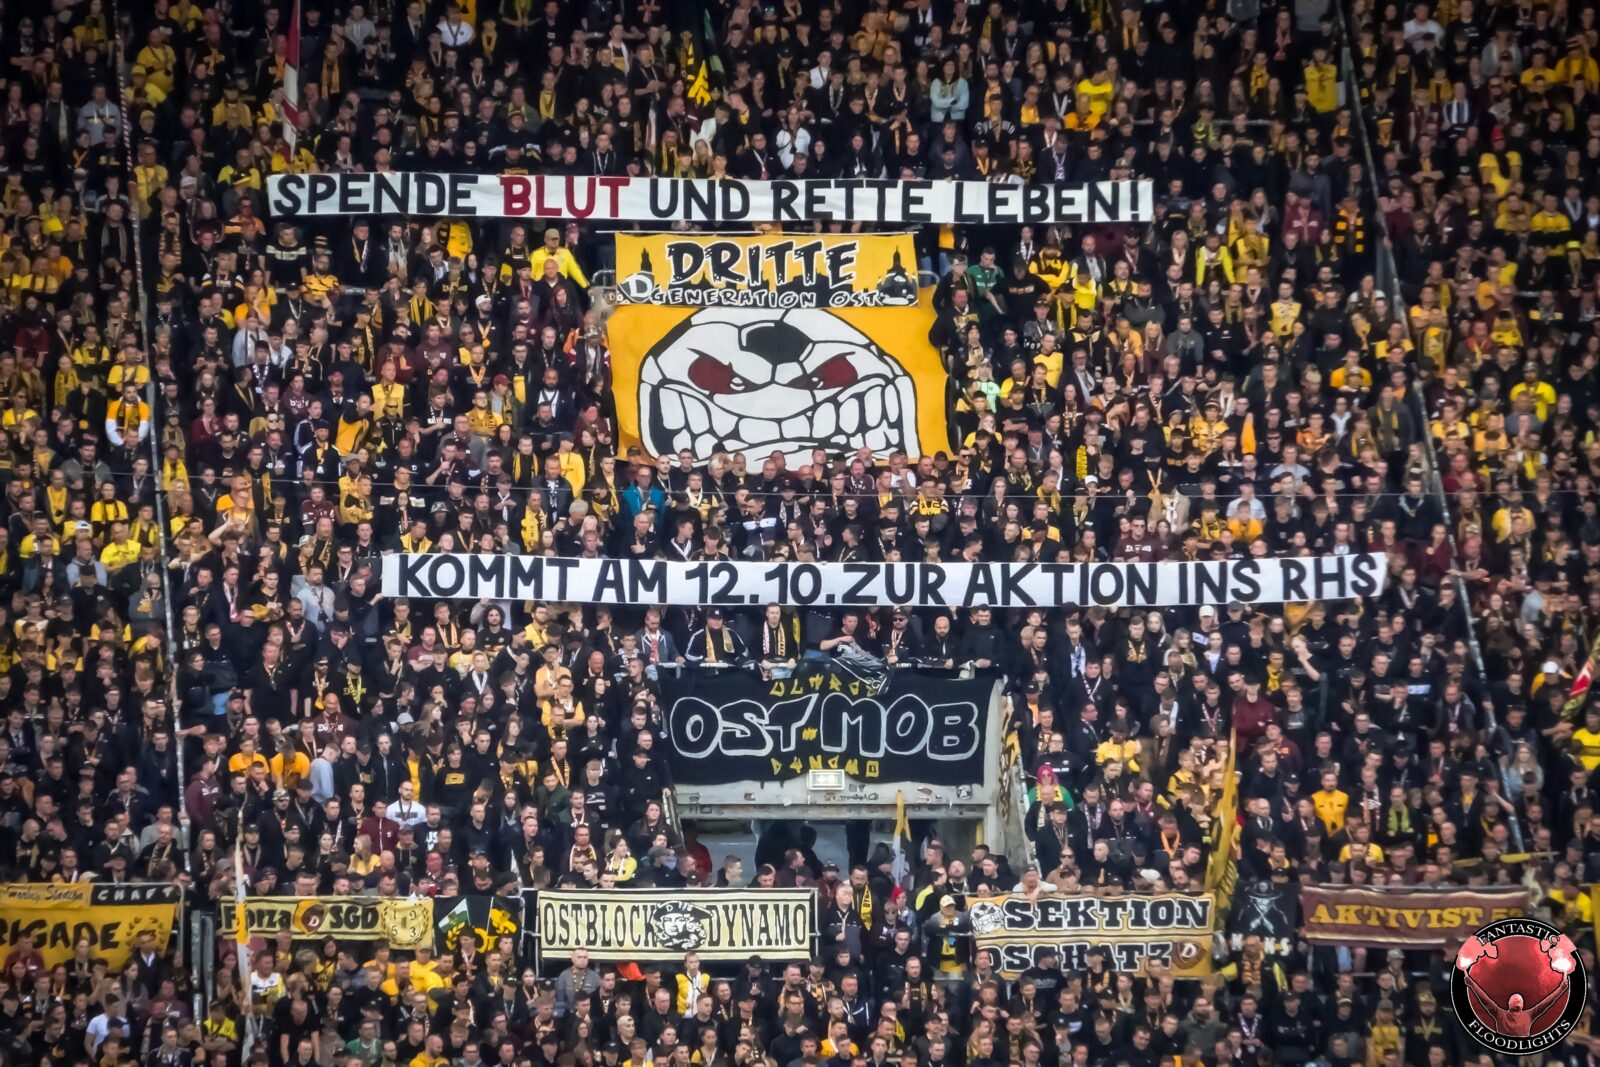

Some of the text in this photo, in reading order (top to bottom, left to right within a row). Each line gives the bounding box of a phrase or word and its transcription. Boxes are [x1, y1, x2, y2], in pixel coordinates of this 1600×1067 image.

[277, 173, 1140, 223] SPENDE BLUT UND RETTE LEBEN!
[665, 240, 860, 288] DRITTE
[650, 289, 881, 308] GENERATION OST
[400, 554, 580, 599] KOMMT
[592, 559, 668, 603] AM
[962, 563, 1158, 606] AKTION
[1178, 559, 1262, 604] INS
[1281, 552, 1378, 601] RHS
[329, 905, 379, 930] SGD
[543, 902, 657, 948] OSTBLOCK
[707, 903, 808, 948] DYNAMO
[1003, 897, 1212, 931] SEKTION
[1310, 903, 1484, 929] AKTIVIST
